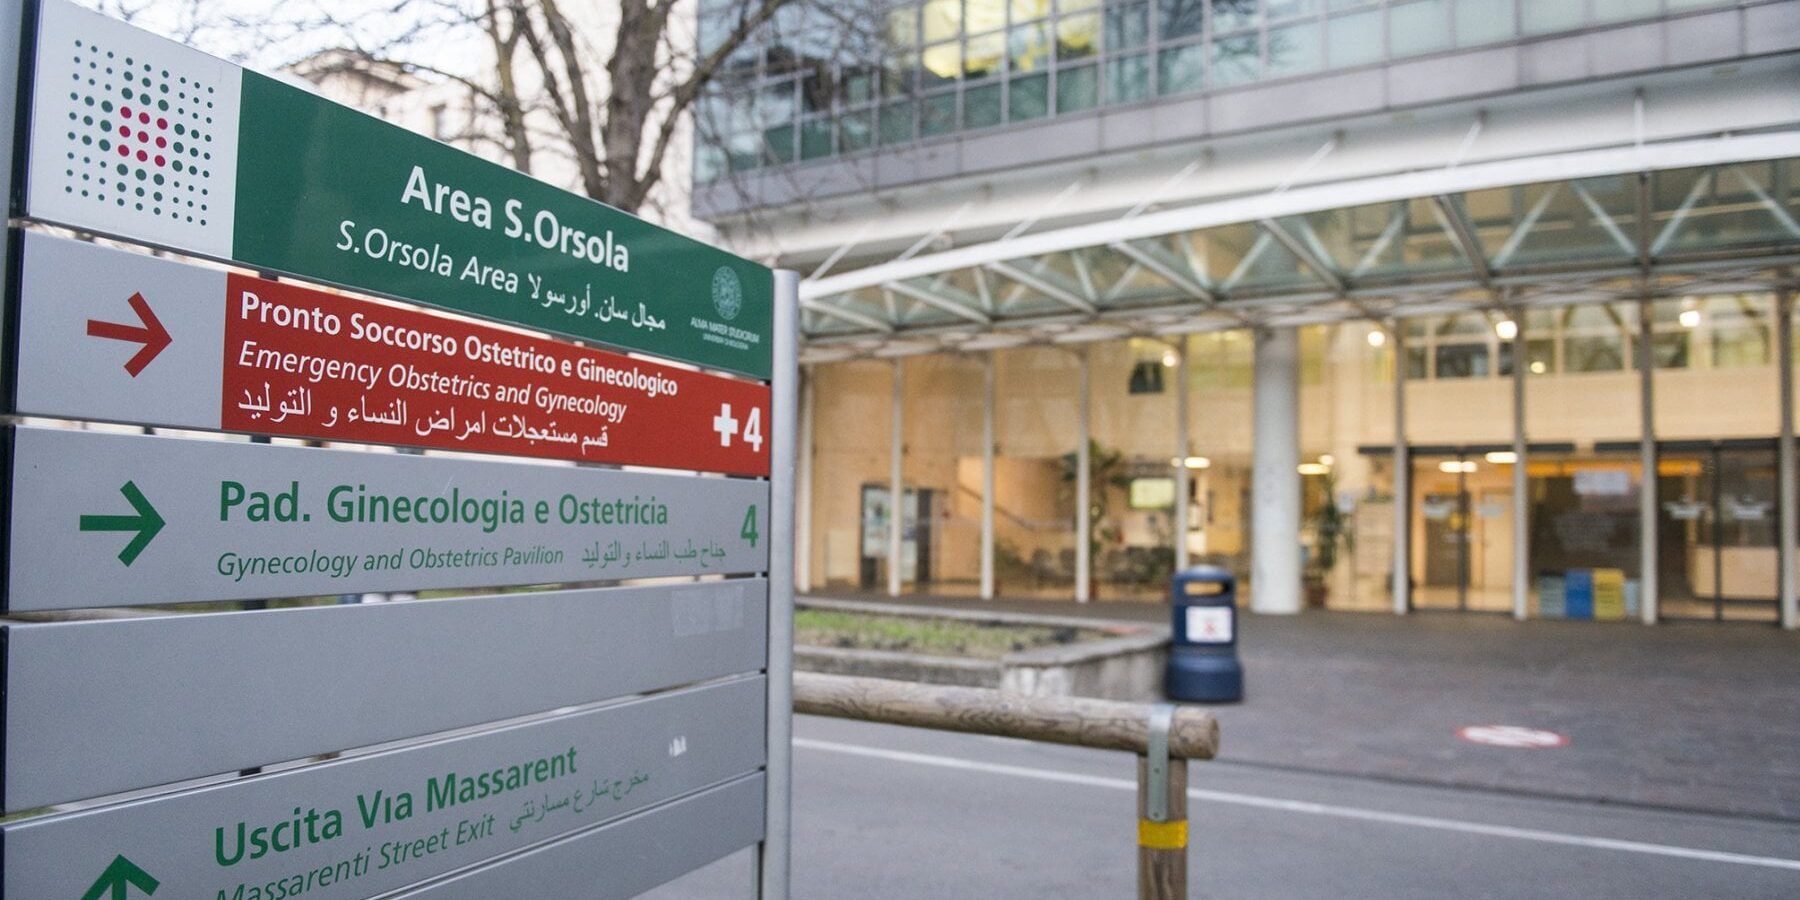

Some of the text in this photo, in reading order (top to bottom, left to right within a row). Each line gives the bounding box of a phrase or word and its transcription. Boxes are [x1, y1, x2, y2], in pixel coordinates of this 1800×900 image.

[401, 165, 630, 273] Area S.Orsola
[336, 220, 519, 294] S.Orsola Area
[631, 302, 667, 331] مجال
[241, 290, 678, 398] Pronto Soccorso Ostetrico e Ginecologico
[238, 340, 627, 423] Emergency Obstetrics and Gynecology
[238, 382, 312, 423] التوليد
[321, 404, 339, 428] و
[347, 395, 408, 426] النساء
[492, 414, 578, 445] مستعجلات
[581, 424, 609, 455] قسم
[743, 406, 763, 453] 4
[219, 480, 669, 534] Pad. Ginecologia e Ostetricia
[740, 504, 759, 548] 4
[217, 546, 564, 582] Gynecology and Obstetrics Pavilion
[636, 539, 669, 561] النساء
[674, 539, 698, 565] طب
[701, 540, 726, 568] جناح
[215, 806, 343, 867] Uscita
[378, 827, 449, 870] Street
[456, 813, 495, 846] Exit
